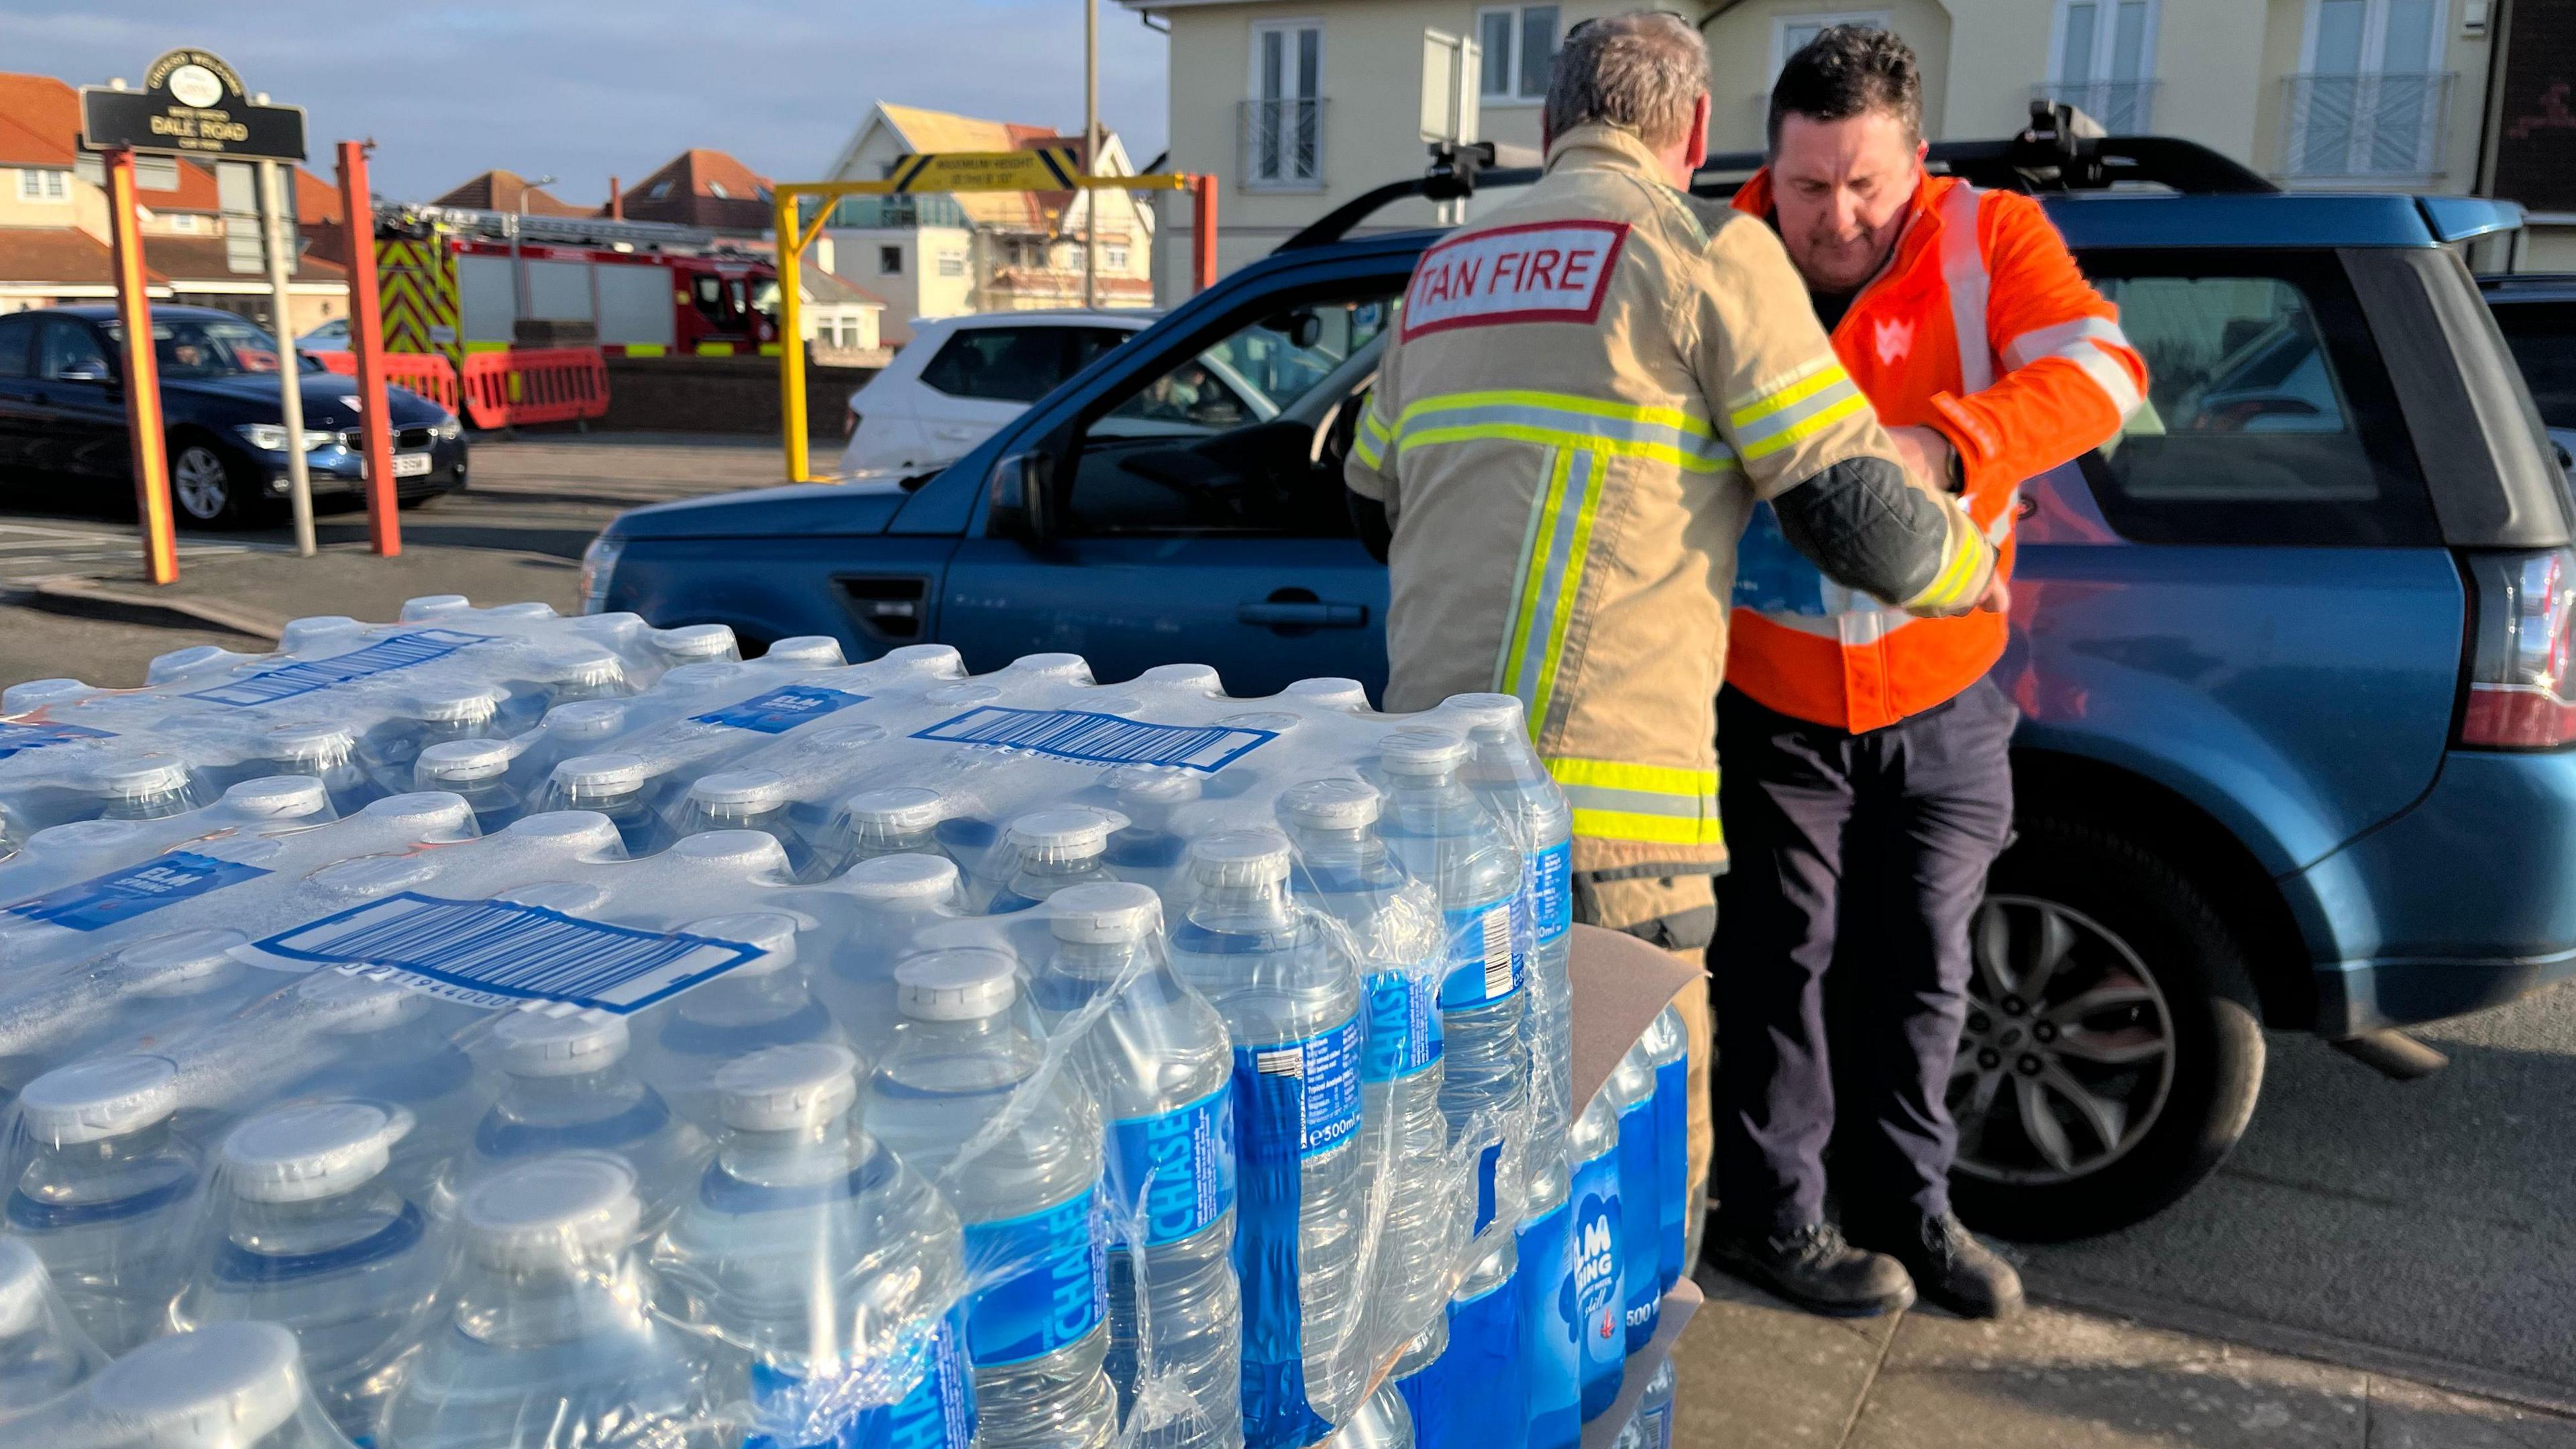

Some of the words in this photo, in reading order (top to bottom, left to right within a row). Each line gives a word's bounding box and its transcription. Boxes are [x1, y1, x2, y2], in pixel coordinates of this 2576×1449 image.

[151, 115, 199, 137] DALE
[200, 119, 248, 142] ROAD
[1488, 249, 1589, 295] FIRE
[772, 695, 824, 707] ELM
[113, 877, 173, 893] SPRING
[134, 866, 203, 887] ELM
[1148, 1112, 1194, 1238] CHASE
[1574, 1214, 1611, 1263] LM
[1585, 1287, 1607, 1319] still
[1626, 1302, 1651, 1326] 500
